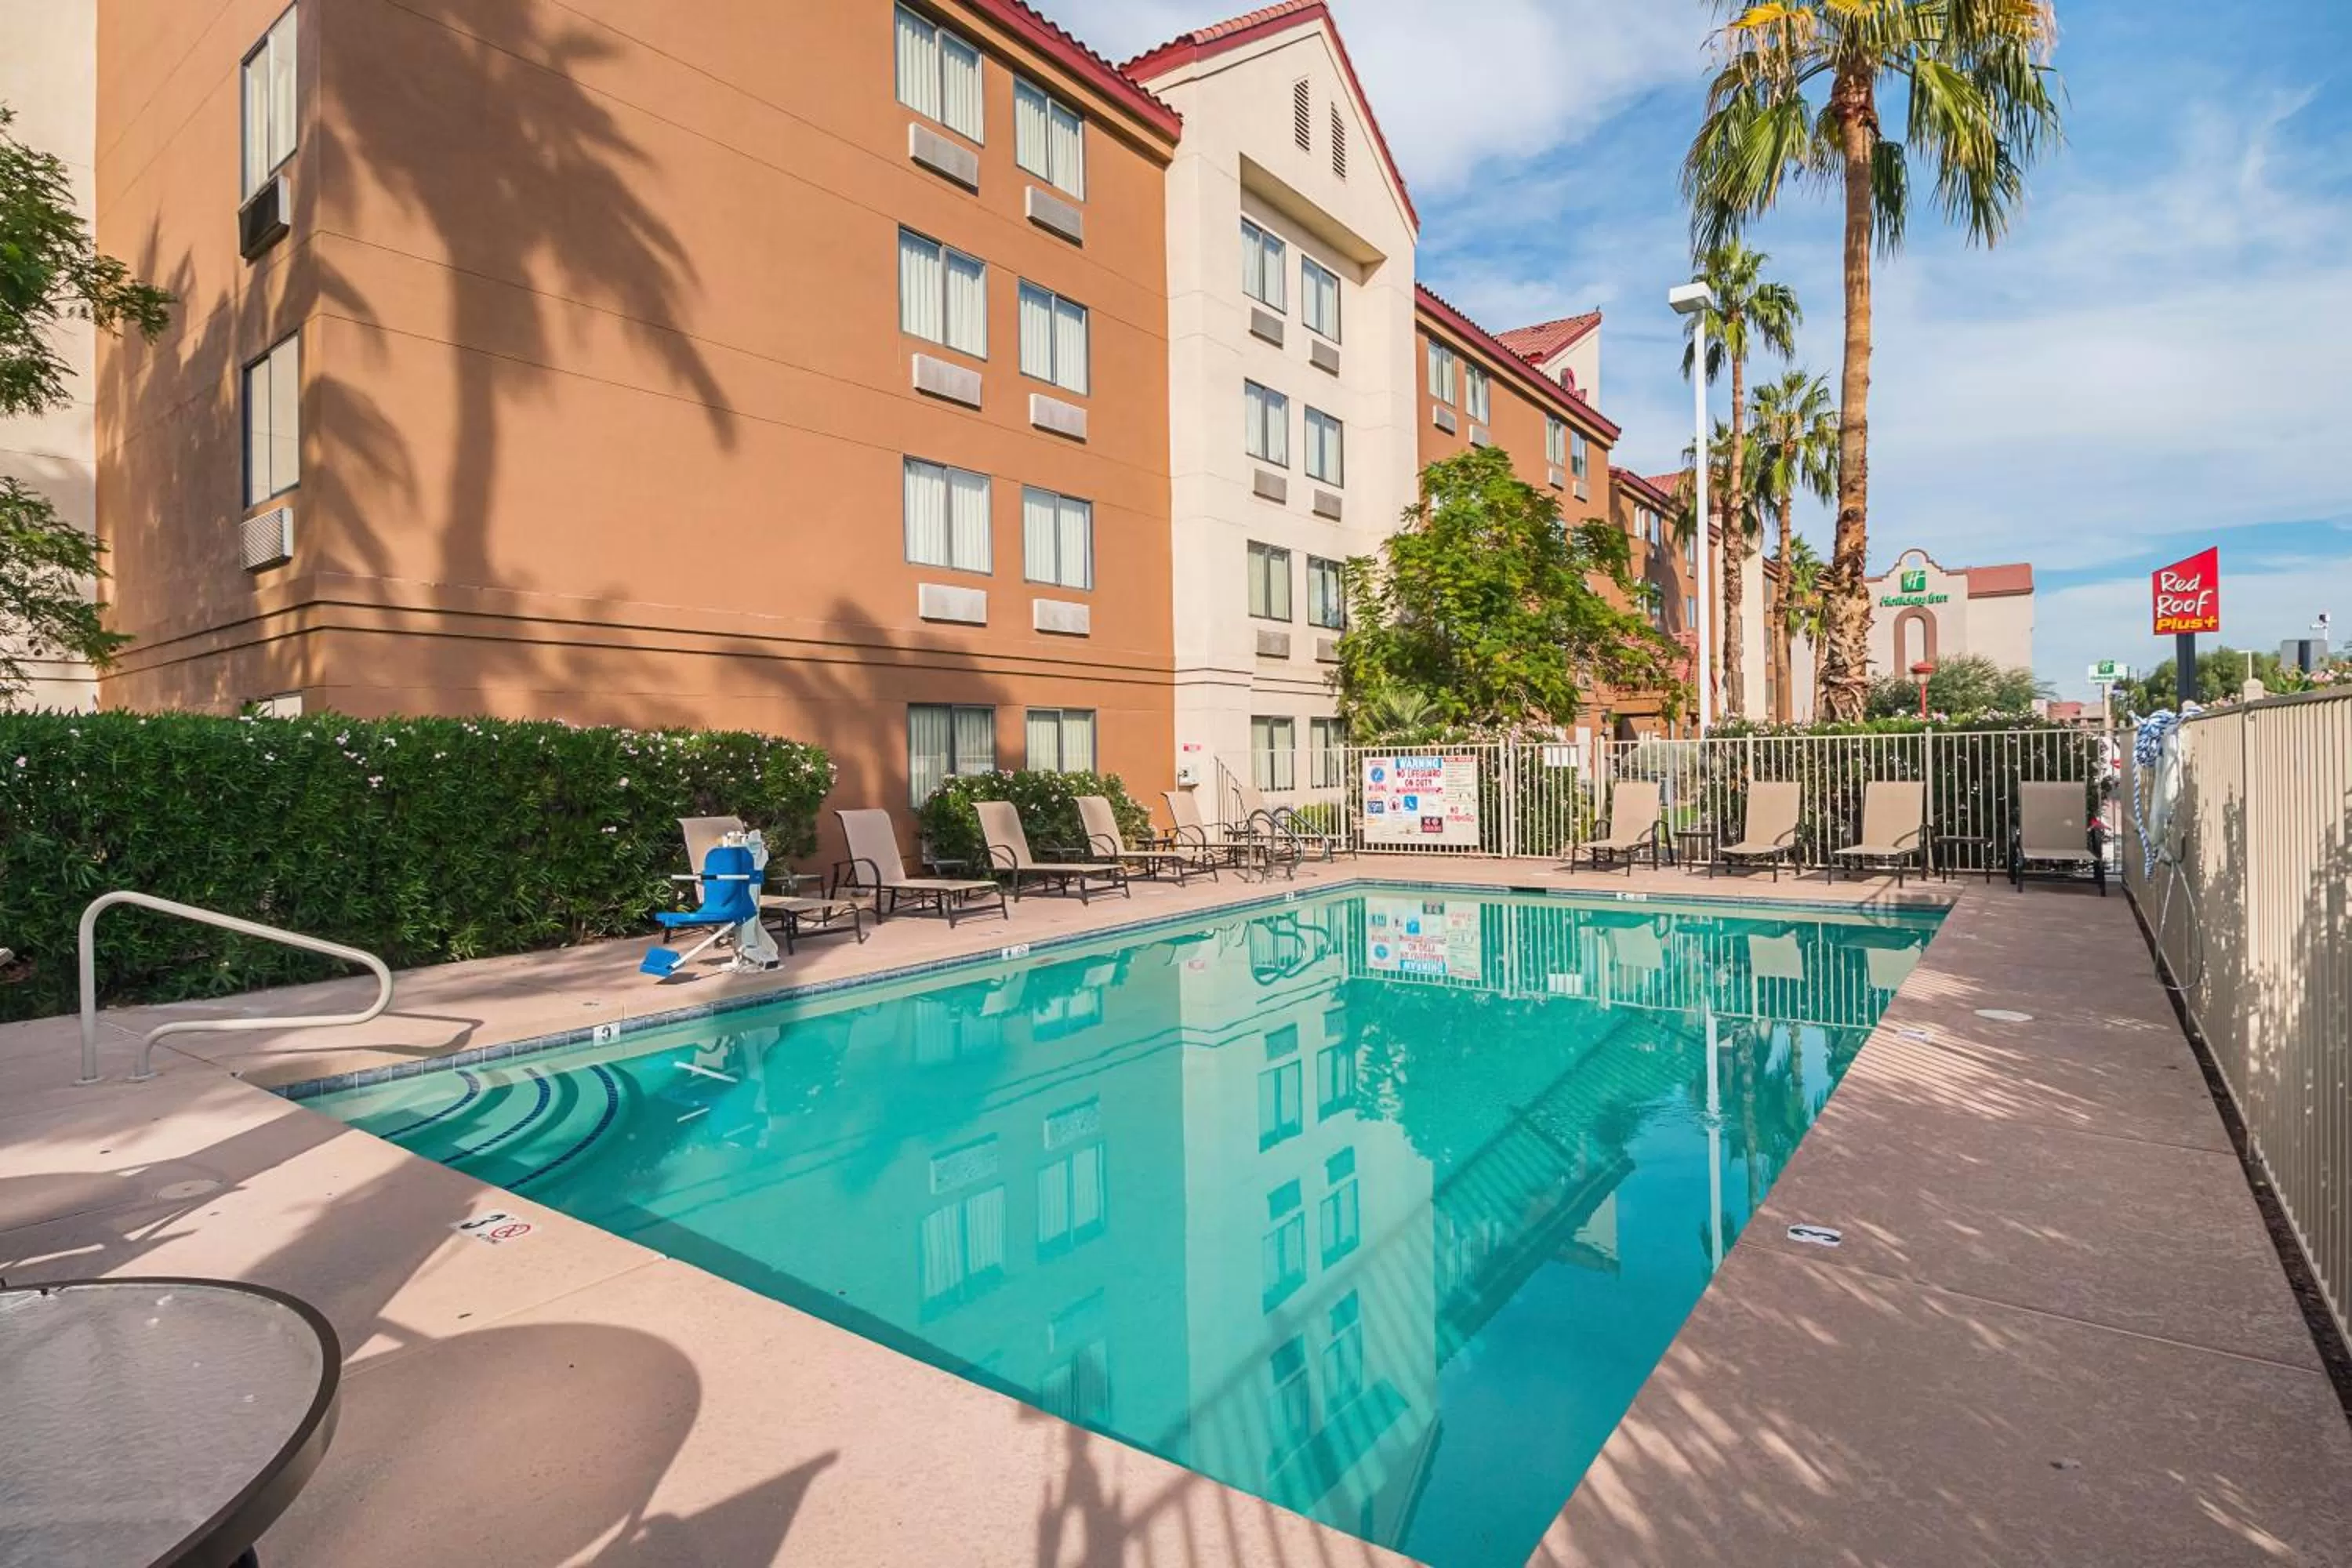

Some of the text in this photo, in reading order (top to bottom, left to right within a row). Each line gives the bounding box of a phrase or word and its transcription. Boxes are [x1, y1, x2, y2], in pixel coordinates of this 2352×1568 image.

[2161, 572, 2201, 592] Red
[2157, 590, 2213, 618] Roof
[1399, 758, 1439, 768] WARNING
[1396, 769, 1406, 779] NO
